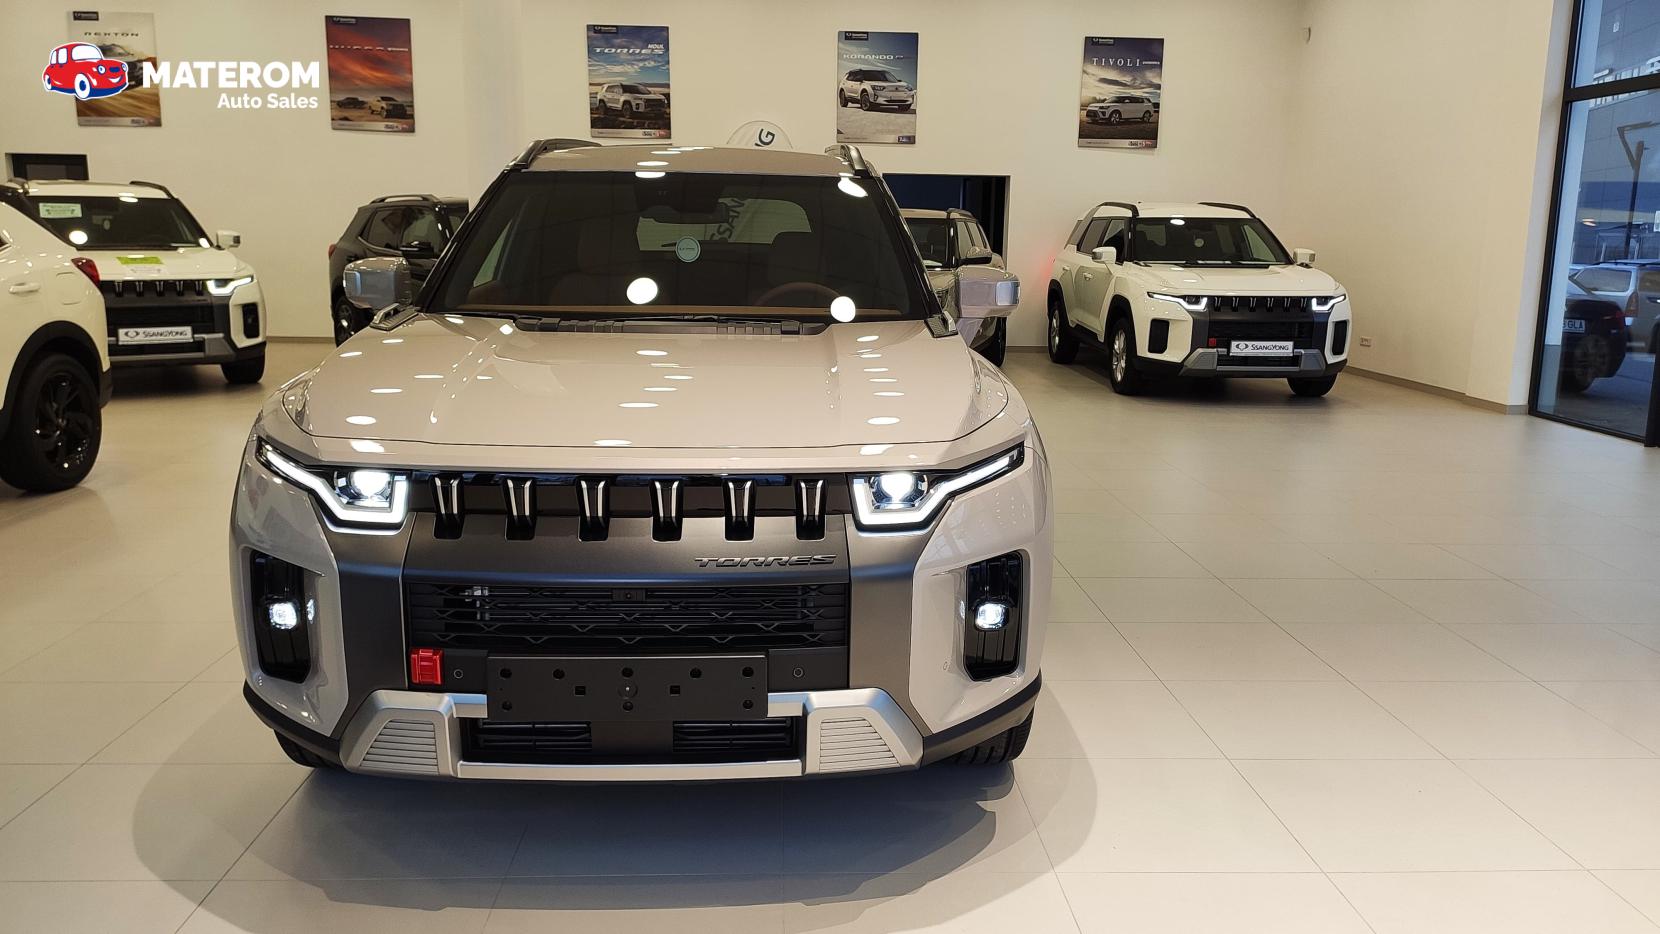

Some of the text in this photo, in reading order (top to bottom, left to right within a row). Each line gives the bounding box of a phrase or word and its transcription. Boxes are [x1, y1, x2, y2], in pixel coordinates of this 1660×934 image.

[593, 47, 665, 55] TORRES
[1092, 57, 1141, 67] TIVOLI
[694, 554, 838, 568] TORRES
